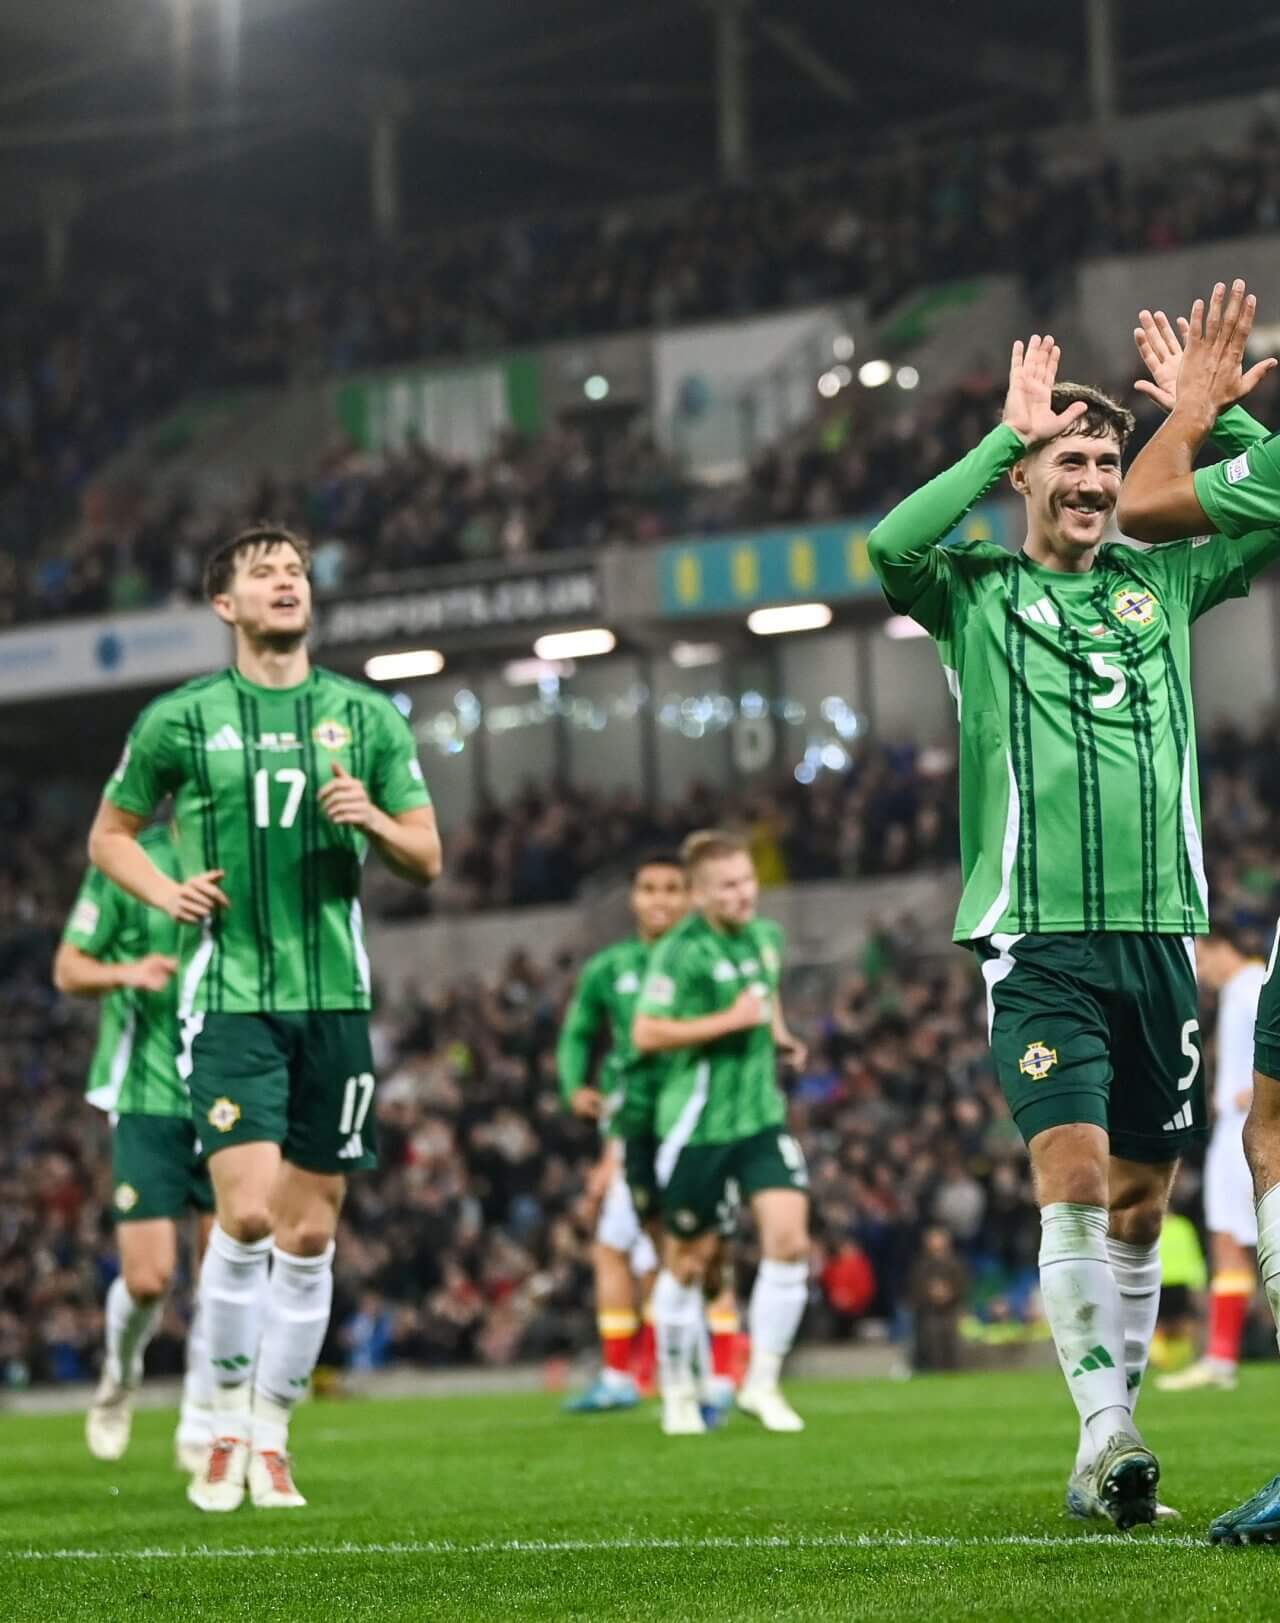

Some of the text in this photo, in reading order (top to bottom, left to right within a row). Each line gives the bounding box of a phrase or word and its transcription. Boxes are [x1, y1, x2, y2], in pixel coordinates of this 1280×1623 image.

[1087, 652, 1127, 709] 5
[255, 767, 307, 829] 17
[1177, 1019, 1200, 1091] 5
[339, 1072, 376, 1135] 17
